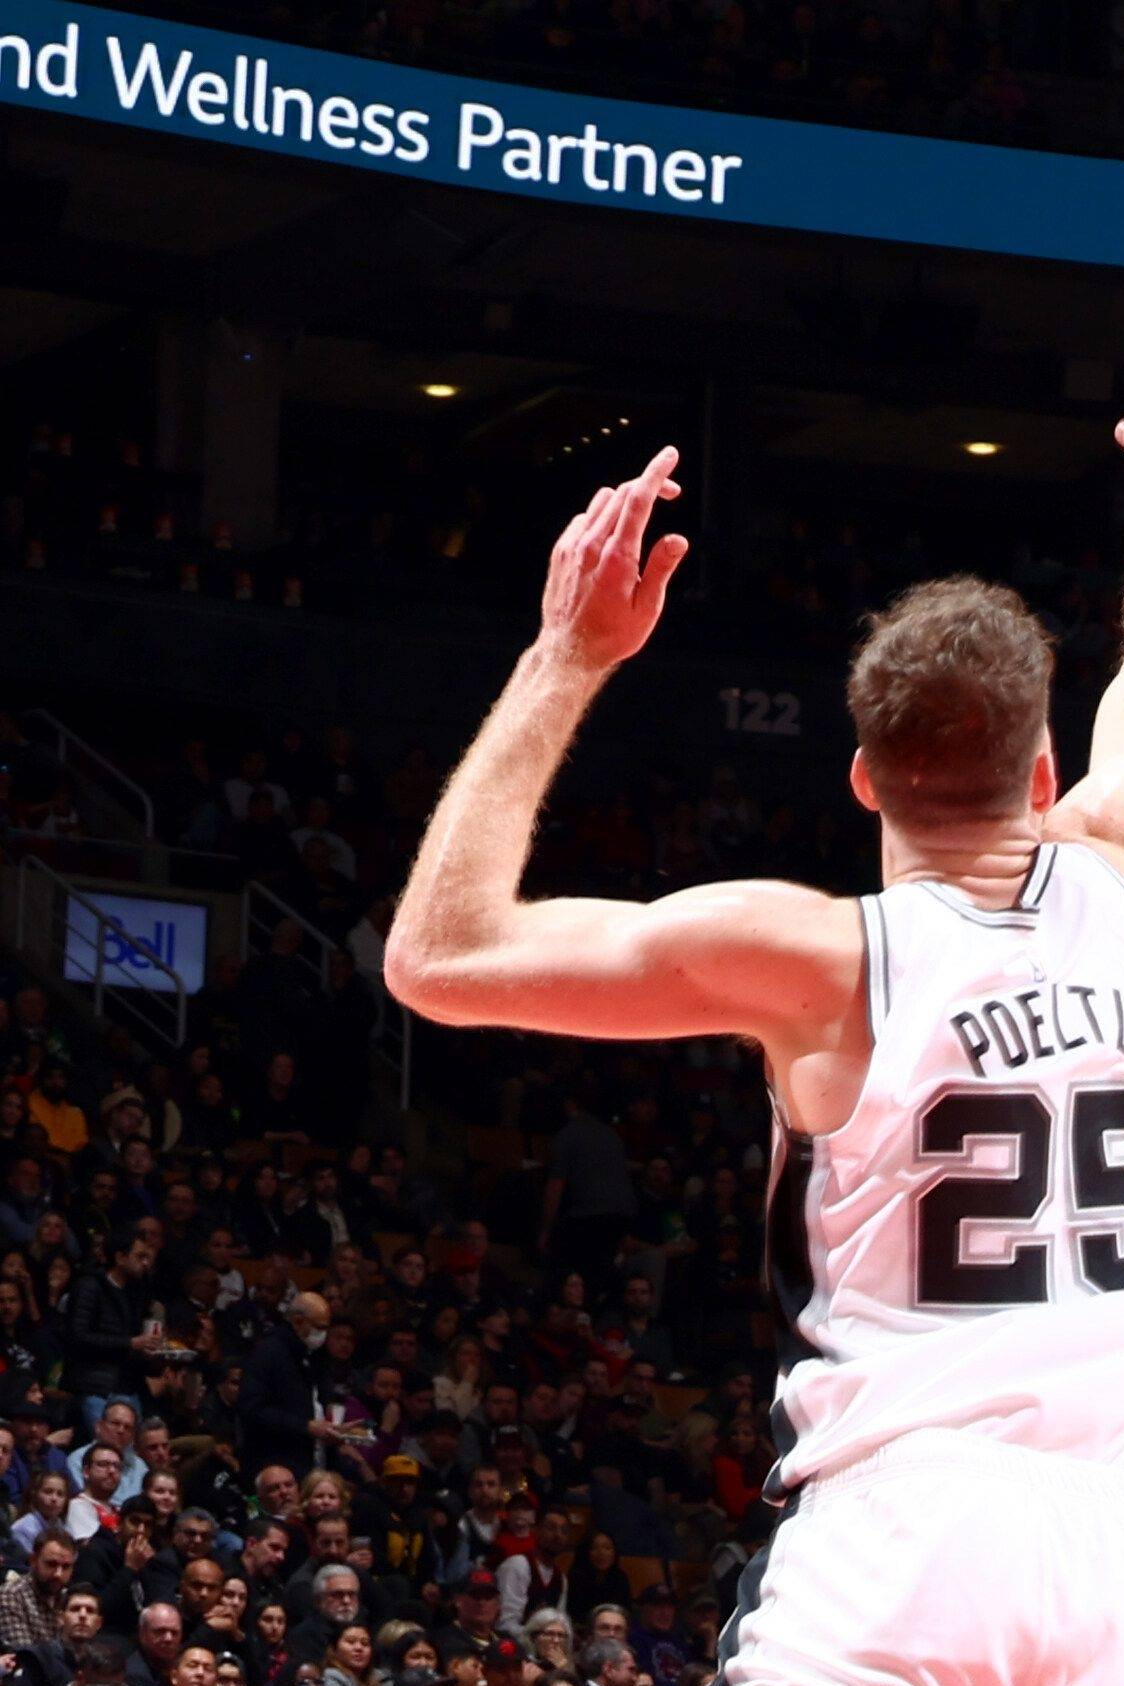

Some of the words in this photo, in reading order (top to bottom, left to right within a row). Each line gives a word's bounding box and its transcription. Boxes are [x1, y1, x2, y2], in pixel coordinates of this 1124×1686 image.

[106, 36, 430, 162] Wellness
[458, 102, 743, 204] Partner
[718, 687, 802, 735] 122
